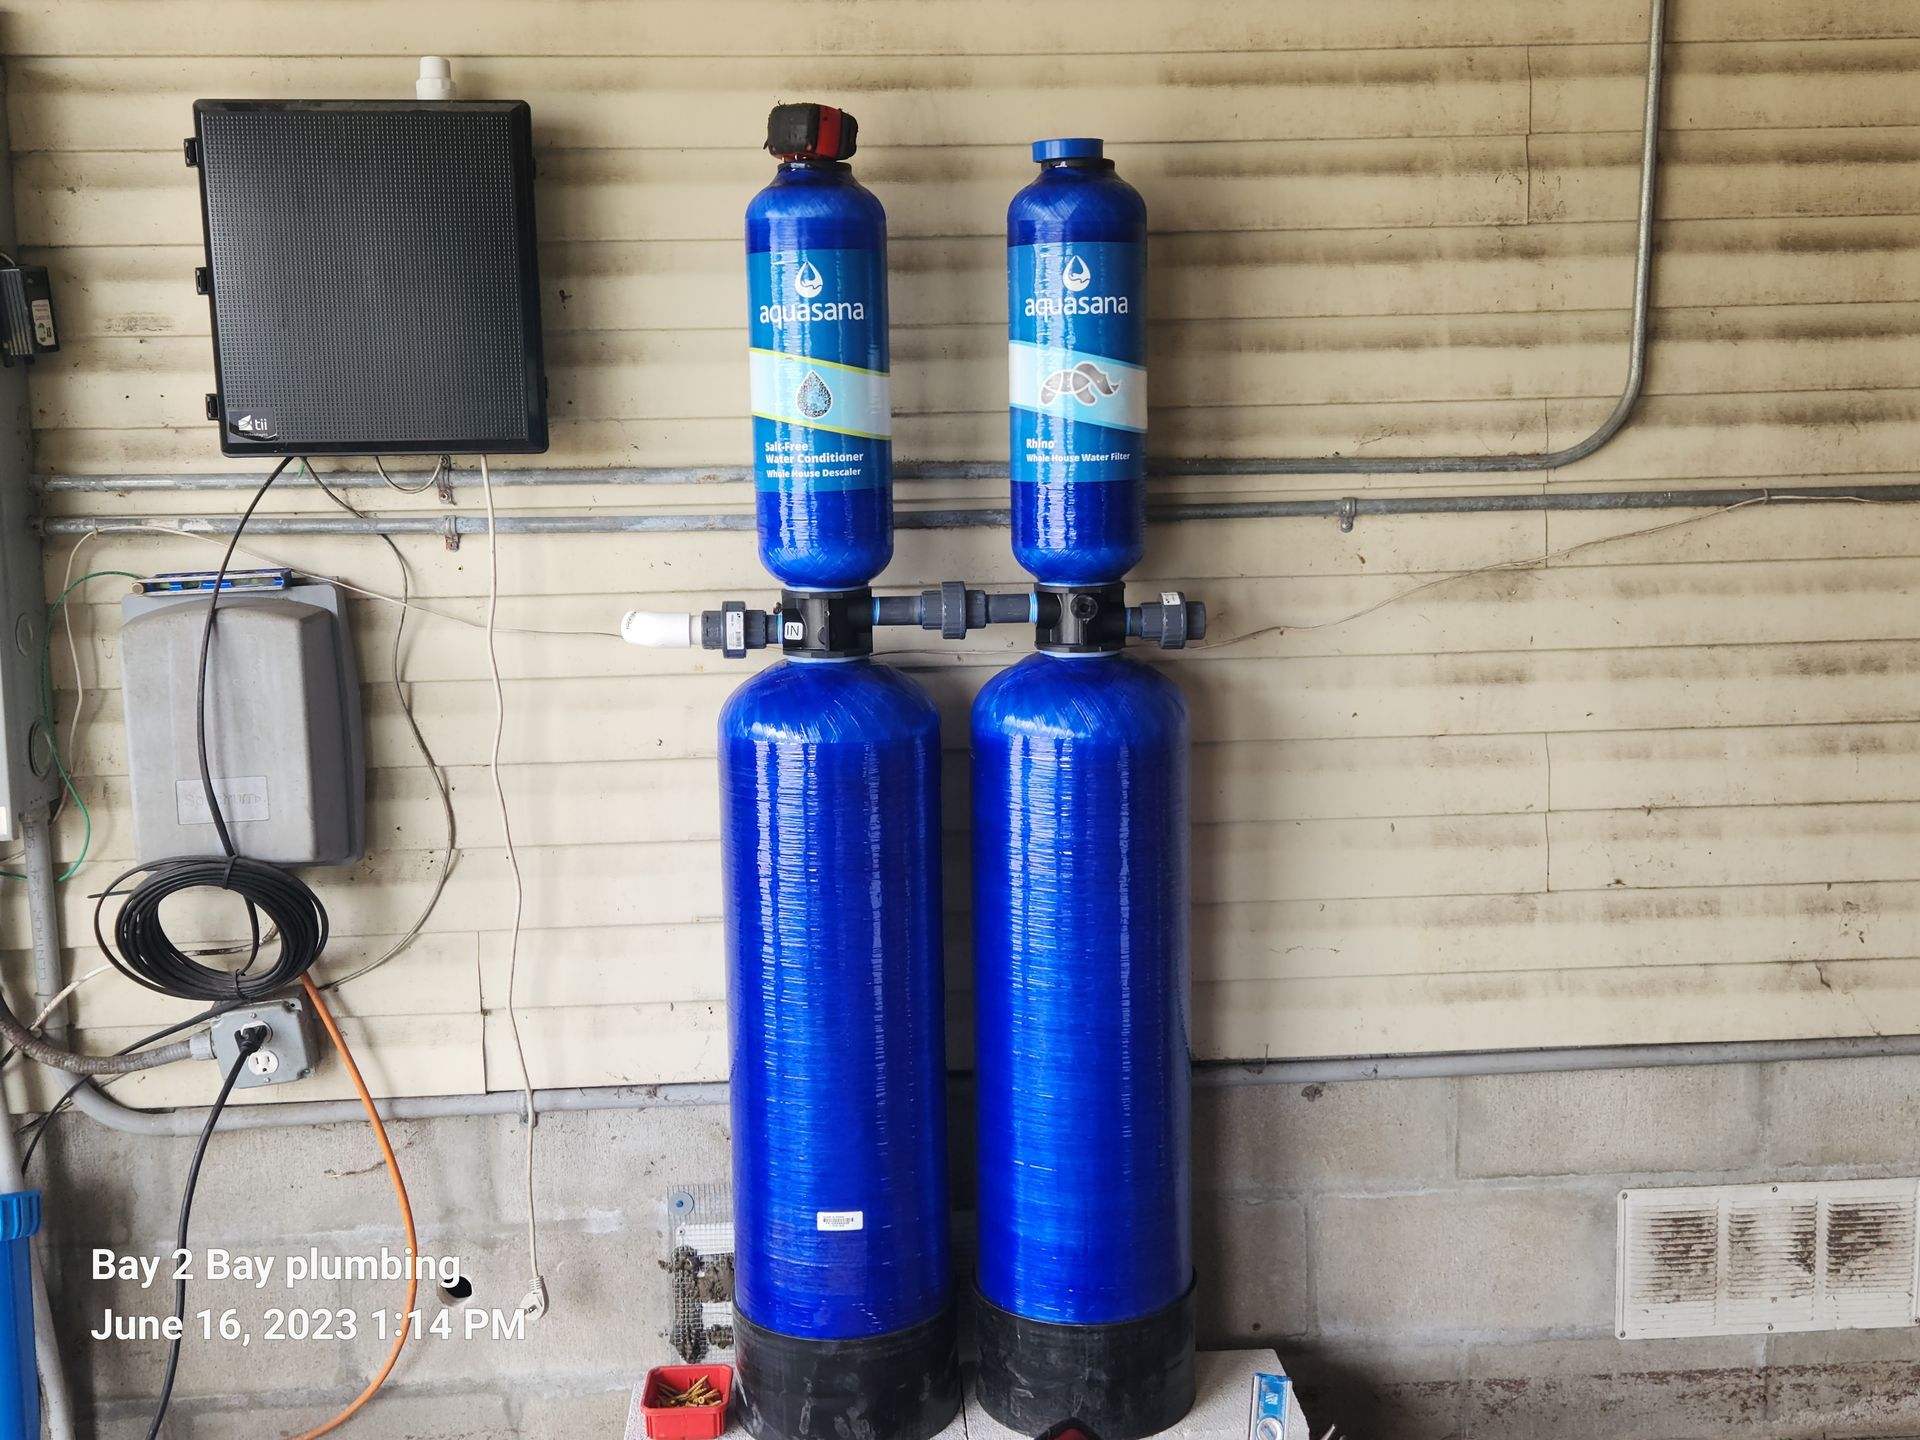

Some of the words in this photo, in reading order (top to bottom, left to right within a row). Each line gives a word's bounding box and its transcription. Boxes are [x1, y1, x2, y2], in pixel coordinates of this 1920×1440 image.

[1025, 296, 1128, 322] aquasana
[760, 302, 864, 329] aquasana
[255, 418, 267, 430] tii
[765, 441, 809, 452] Salt-Free
[1026, 438, 1055, 449] Rhino
[765, 454, 795, 464] Water
[797, 452, 864, 464] Conditioner
[1026, 454, 1050, 463] Whole
[1051, 454, 1080, 463] House
[1081, 453, 1109, 462] Water
[1110, 452, 1131, 461] Filter
[766, 469, 790, 478] Whole
[792, 469, 820, 478] House
[822, 468, 861, 477] Descaler
[786, 625, 800, 636] IN
